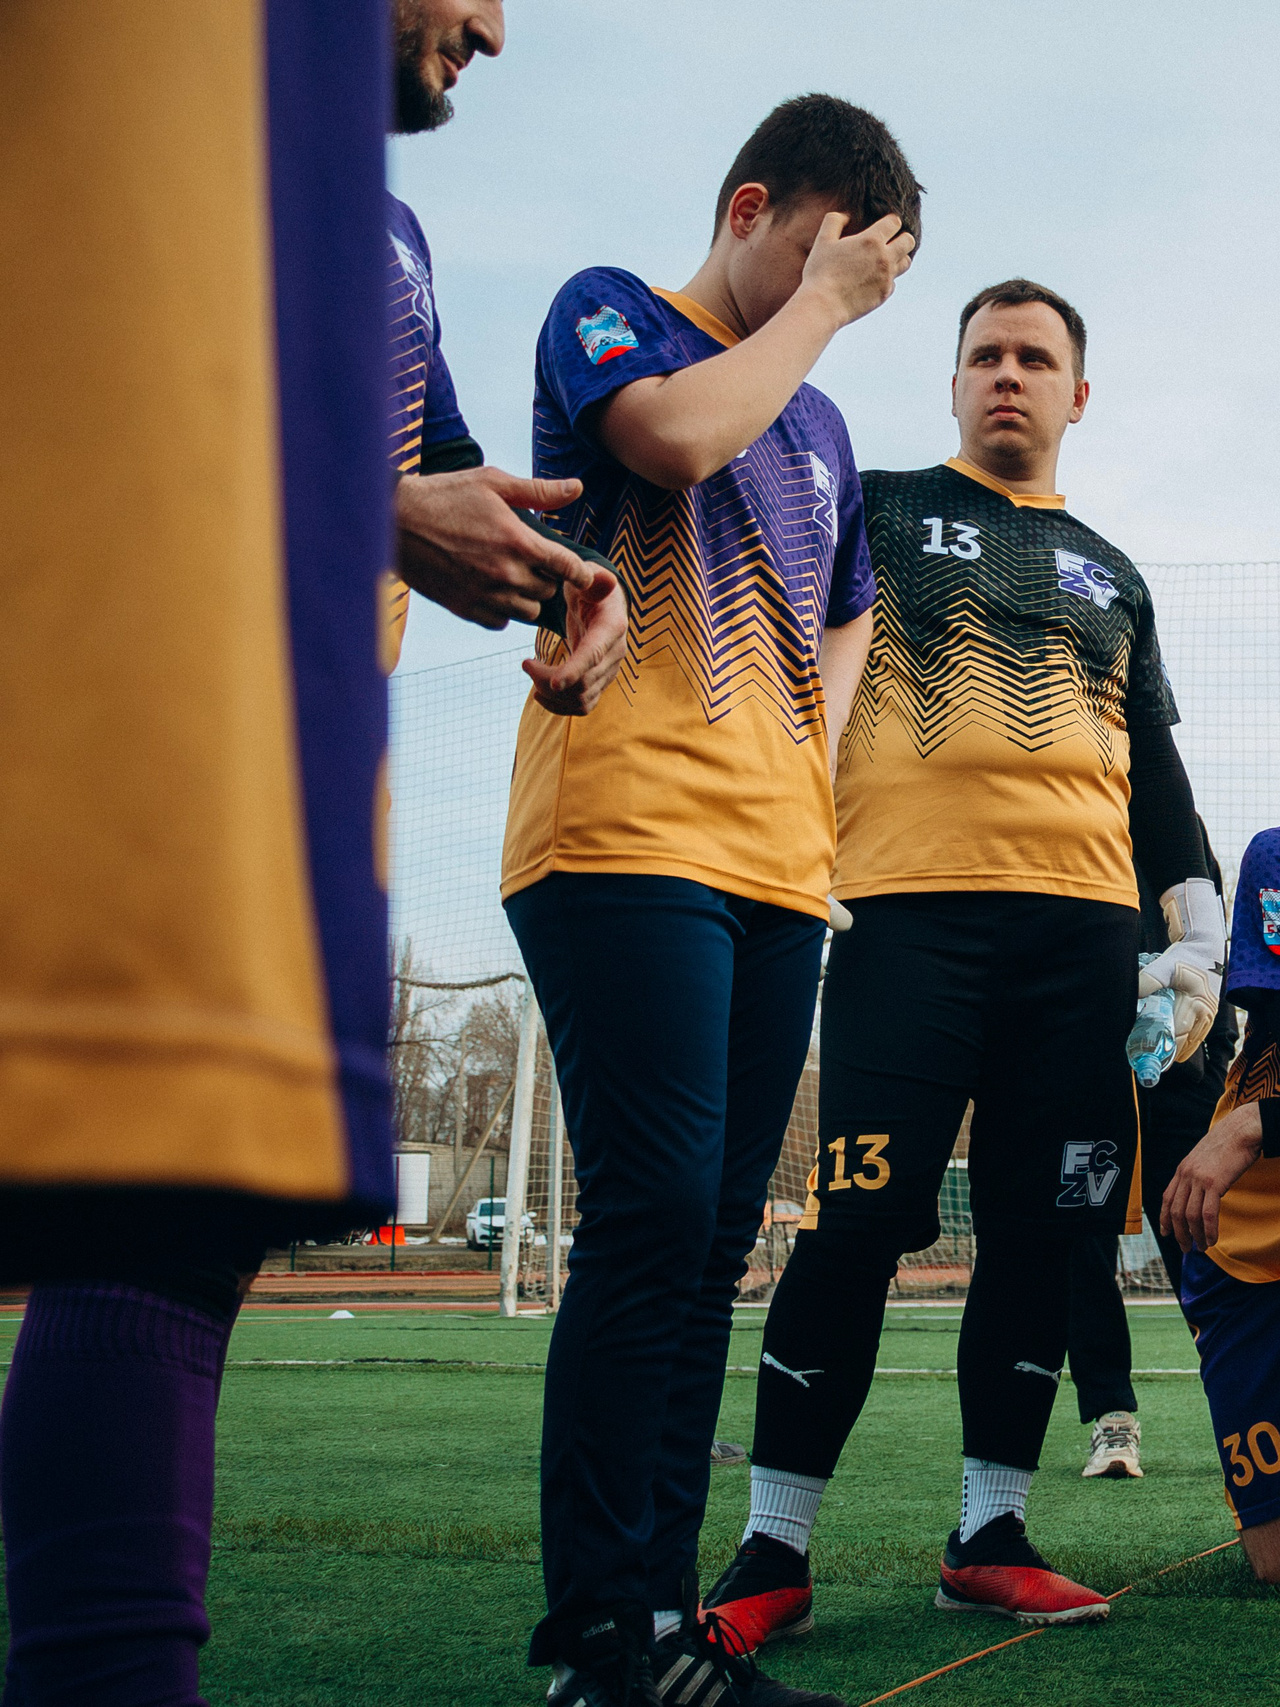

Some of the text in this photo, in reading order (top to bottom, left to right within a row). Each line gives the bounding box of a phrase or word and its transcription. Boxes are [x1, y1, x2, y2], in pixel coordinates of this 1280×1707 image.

[922, 517, 981, 560] 13
[828, 1134, 890, 1191] 13
[582, 1619, 615, 1638] adidas
